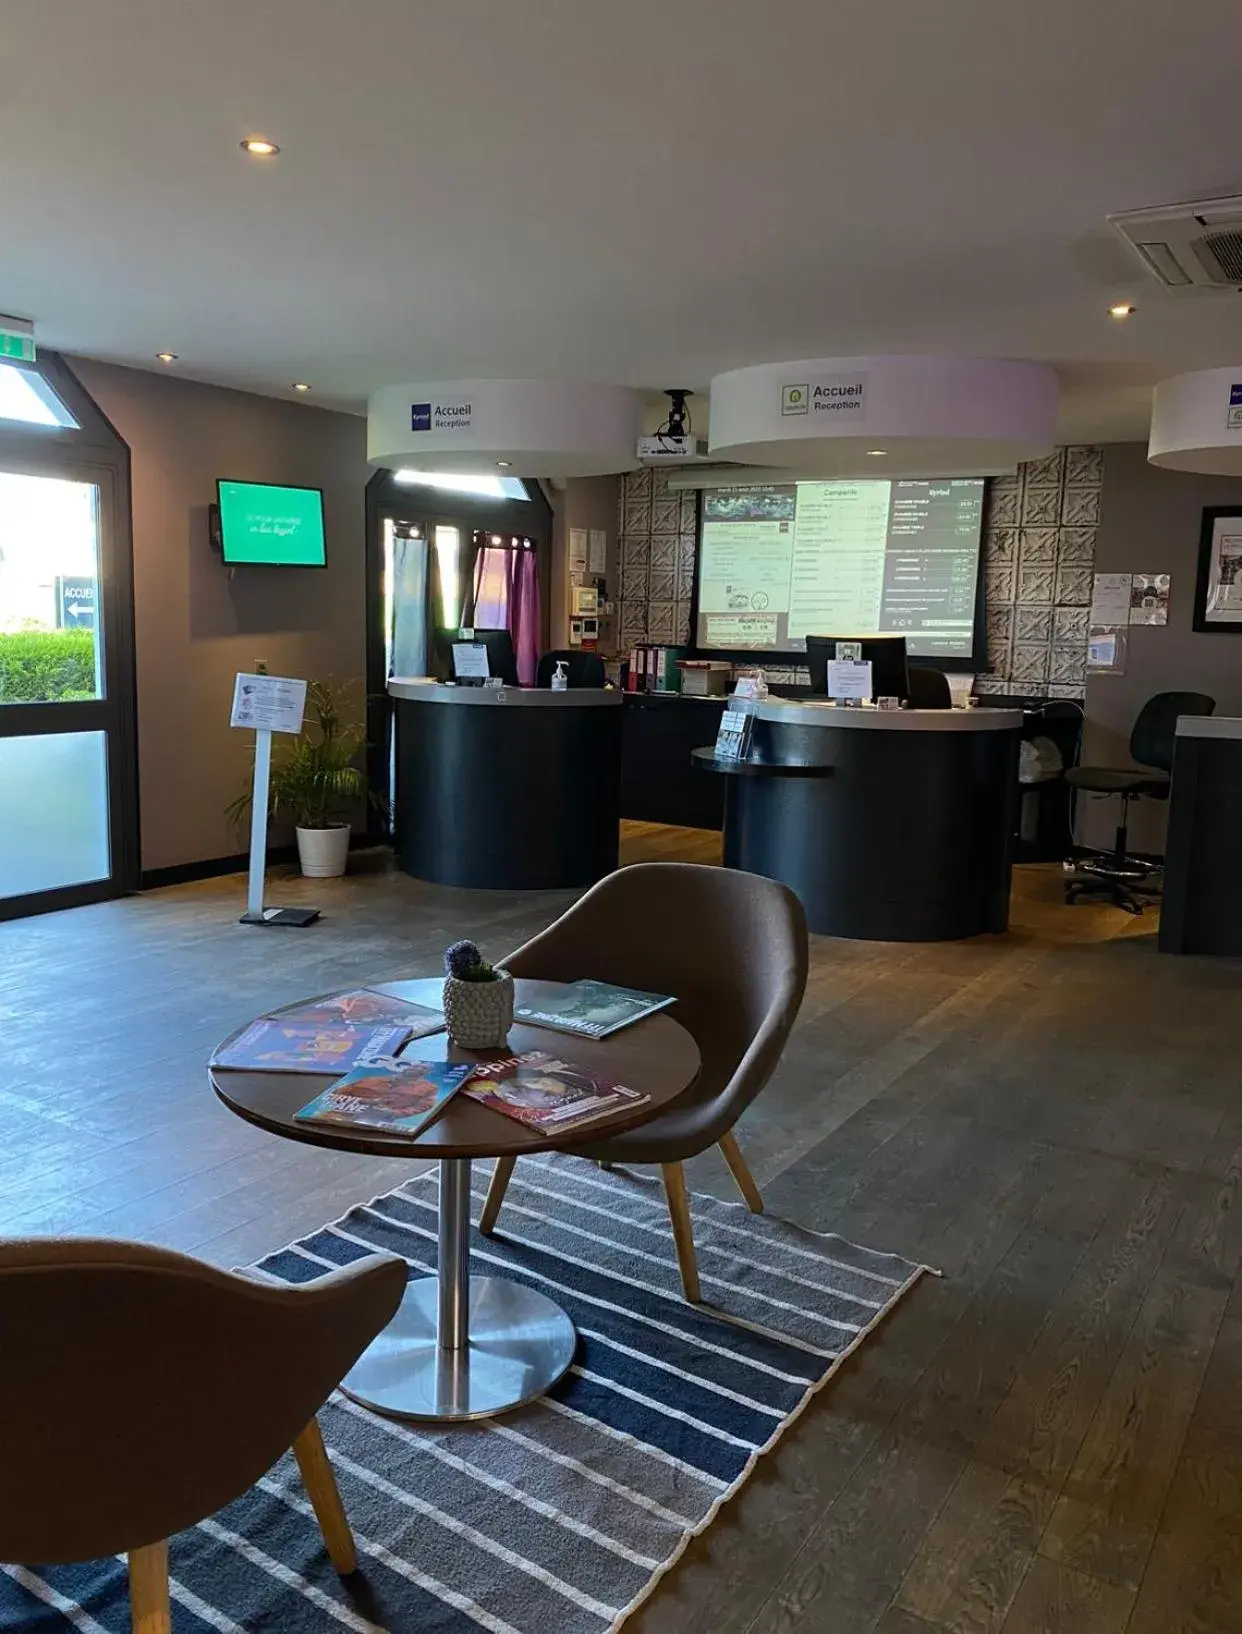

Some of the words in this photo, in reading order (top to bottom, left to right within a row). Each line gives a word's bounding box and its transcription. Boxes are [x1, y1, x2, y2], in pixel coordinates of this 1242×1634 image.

[813, 384, 863, 398] Accueil
[434, 404, 472, 416] Accueil
[815, 401, 862, 412] Reception
[436, 419, 471, 429] Reception
